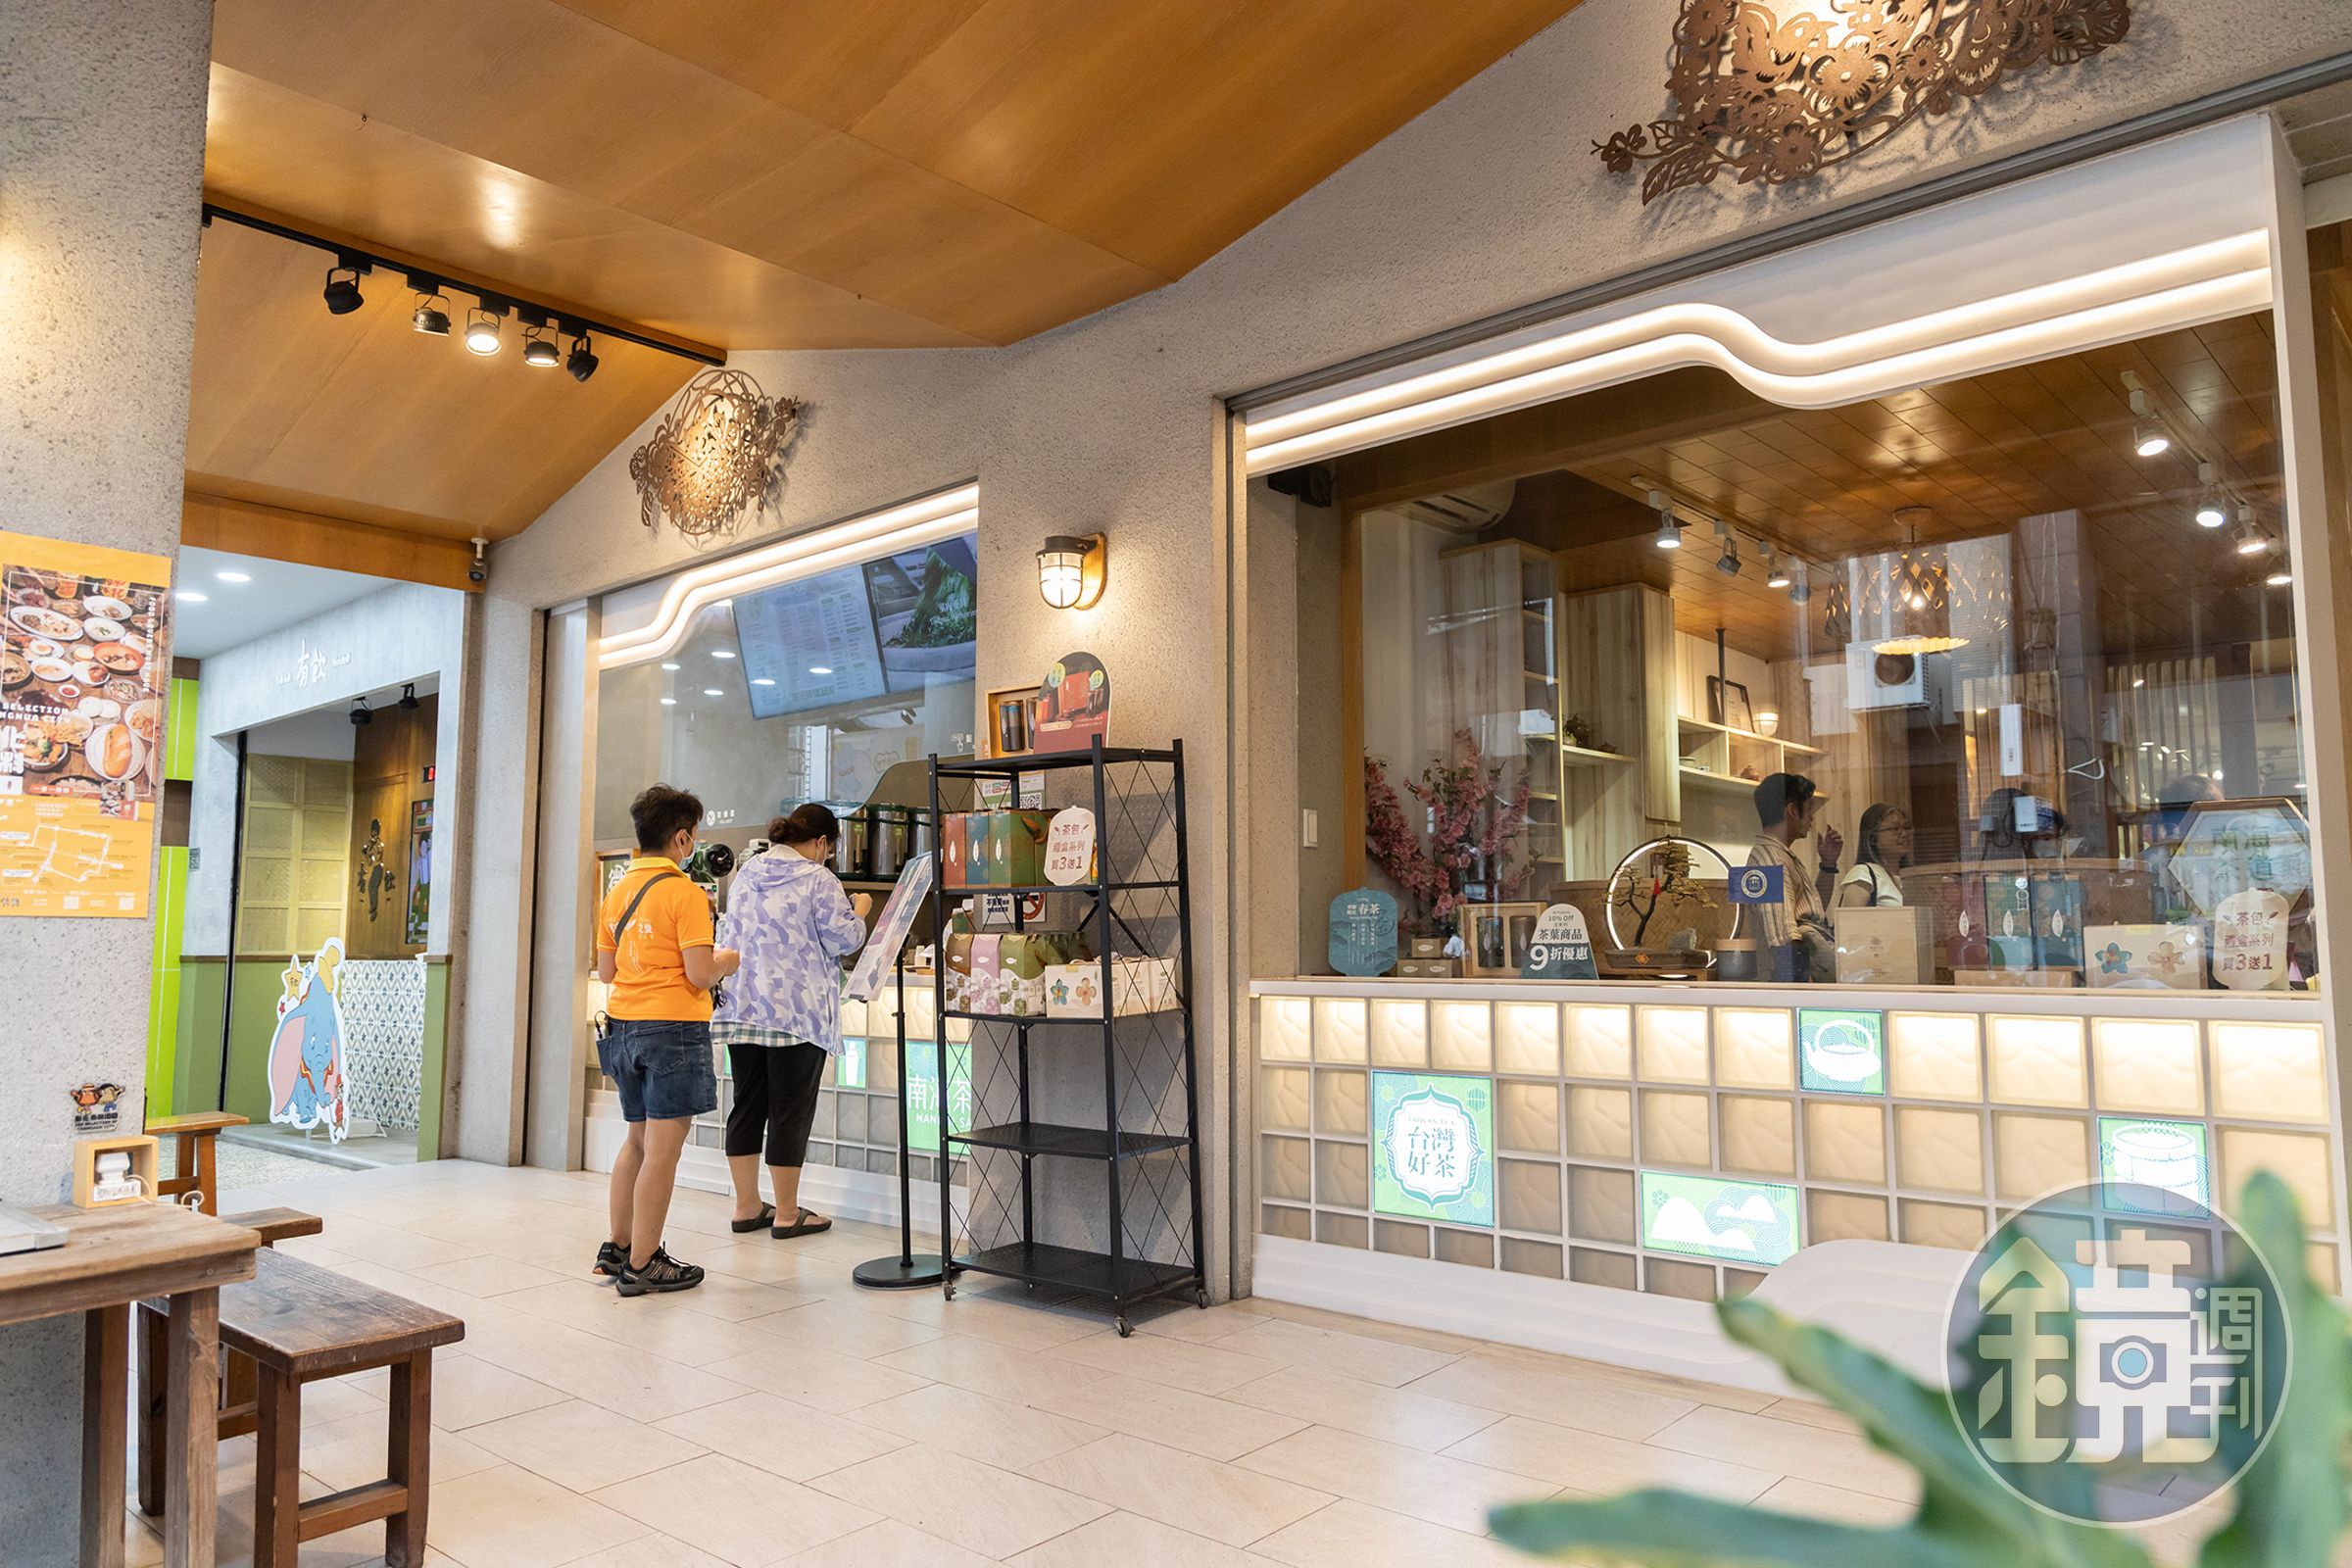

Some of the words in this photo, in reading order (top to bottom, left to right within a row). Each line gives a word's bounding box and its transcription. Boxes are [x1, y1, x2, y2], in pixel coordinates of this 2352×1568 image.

[2, 703, 70, 715] SELECTION
[1062, 823, 1080, 836] 茶包
[1051, 856, 1083, 871] 買3送1
[2235, 910, 2264, 926] 茶包
[1539, 928, 1583, 941] 茶葉商品
[2224, 932, 2275, 950] 禮盒系列
[1529, 944, 1589, 970] 9折優惠
[2222, 953, 2273, 971] 買3送1
[1408, 1126, 1456, 1152] 台灣
[1408, 1151, 1456, 1178] 好茶
